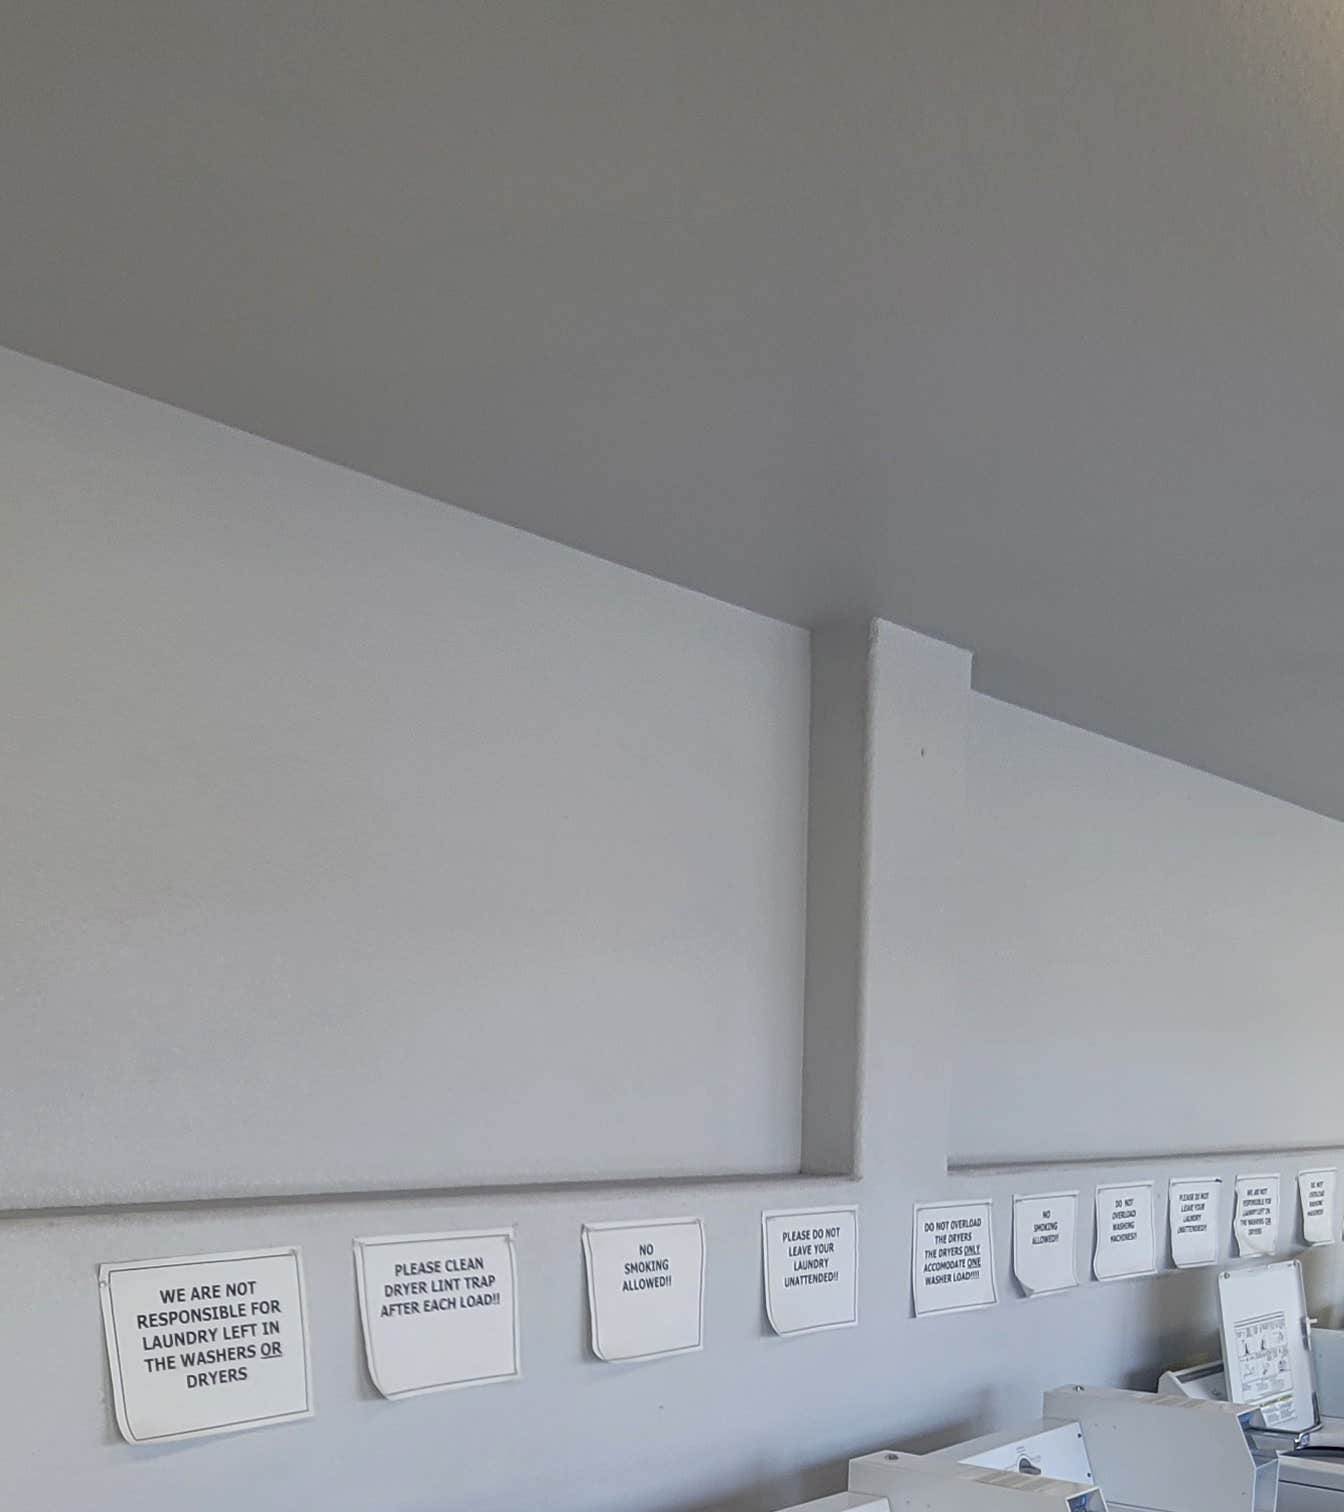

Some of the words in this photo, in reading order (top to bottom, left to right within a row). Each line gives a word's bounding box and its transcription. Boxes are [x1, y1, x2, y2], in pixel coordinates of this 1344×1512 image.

[924, 1222, 934, 1232] DO
[936, 1221, 949, 1230] NOT
[950, 1218, 982, 1230] OVERLOAD
[782, 1230, 811, 1242] PLEASE
[812, 1228, 824, 1240] DO
[825, 1227, 840, 1238] NOT
[935, 1234, 947, 1245] THE
[948, 1232, 972, 1244] DRYERS
[639, 1244, 654, 1256] NO
[789, 1245, 812, 1257] LEAVE
[814, 1243, 834, 1254] YOUR
[925, 1249, 936, 1259] THE
[938, 1246, 963, 1258] DRYERS
[964, 1244, 980, 1256] ONLY
[394, 1261, 441, 1276] PLEASE
[445, 1257, 484, 1272] CLEAN
[624, 1258, 669, 1275] SMOKING
[794, 1257, 829, 1272] LAUNDRY
[967, 1257, 981, 1269] ONE
[384, 1281, 428, 1298] DRYER
[431, 1278, 460, 1293] LINT
[464, 1275, 496, 1289] TRAP
[622, 1275, 672, 1292] ALLOWED!!
[784, 1271, 839, 1288] UNATTENDED!!
[925, 1273, 952, 1286] WASHER
[160, 1288, 186, 1304] WE
[191, 1284, 221, 1301] ARE
[226, 1281, 256, 1297] NOT
[380, 1301, 421, 1318] AFTER
[423, 1297, 456, 1312] EACH
[459, 1292, 500, 1308] LOAD!!
[137, 1303, 247, 1329] RESPONSIBLE
[251, 1300, 281, 1316] FOR
[142, 1328, 218, 1351] LAUNDRY
[223, 1324, 257, 1340] LEFT
[262, 1320, 280, 1336] IN
[144, 1356, 176, 1373] THE
[180, 1345, 256, 1368] WASHERS
[260, 1342, 283, 1359] OR
[186, 1367, 248, 1388] DRYERS
